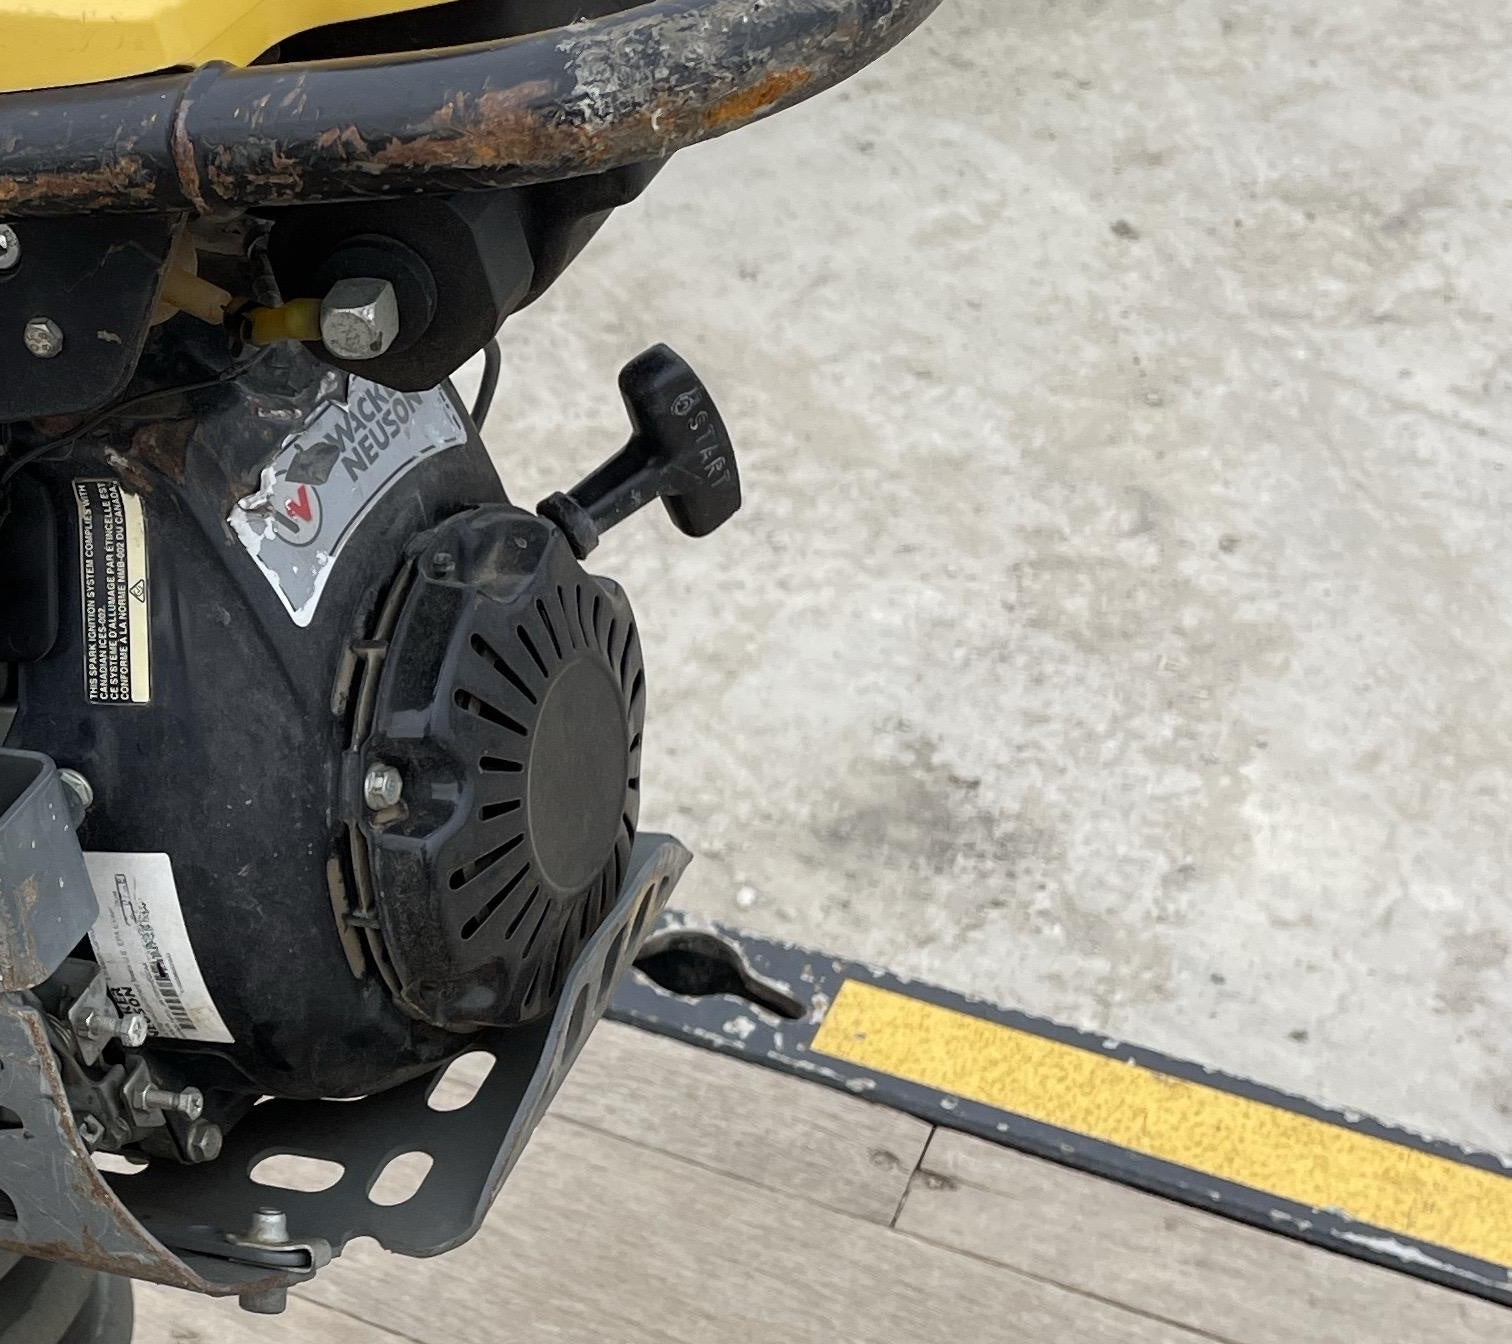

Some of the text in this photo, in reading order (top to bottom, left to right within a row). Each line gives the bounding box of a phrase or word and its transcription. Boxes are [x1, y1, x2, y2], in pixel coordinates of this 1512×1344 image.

[325, 383, 402, 453] WACK
[340, 392, 425, 483] NEUSON
[687, 410, 732, 489] START
[97, 483, 108, 499] EST
[101, 501, 114, 552] ÉTINCELLE
[115, 526, 124, 540] DU
[106, 554, 115, 574] PAR
[116, 542, 125, 583] NMB-002
[78, 485, 98, 699] THIS SPARK IGNITION SYSTEM COMPLIES WITH
[117, 585, 127, 619] NORME
[119, 622, 127, 634] LA
[99, 650, 108, 700] CANADIAN
[110, 687, 118, 700] CE
[119, 646, 129, 700] CONFORME
